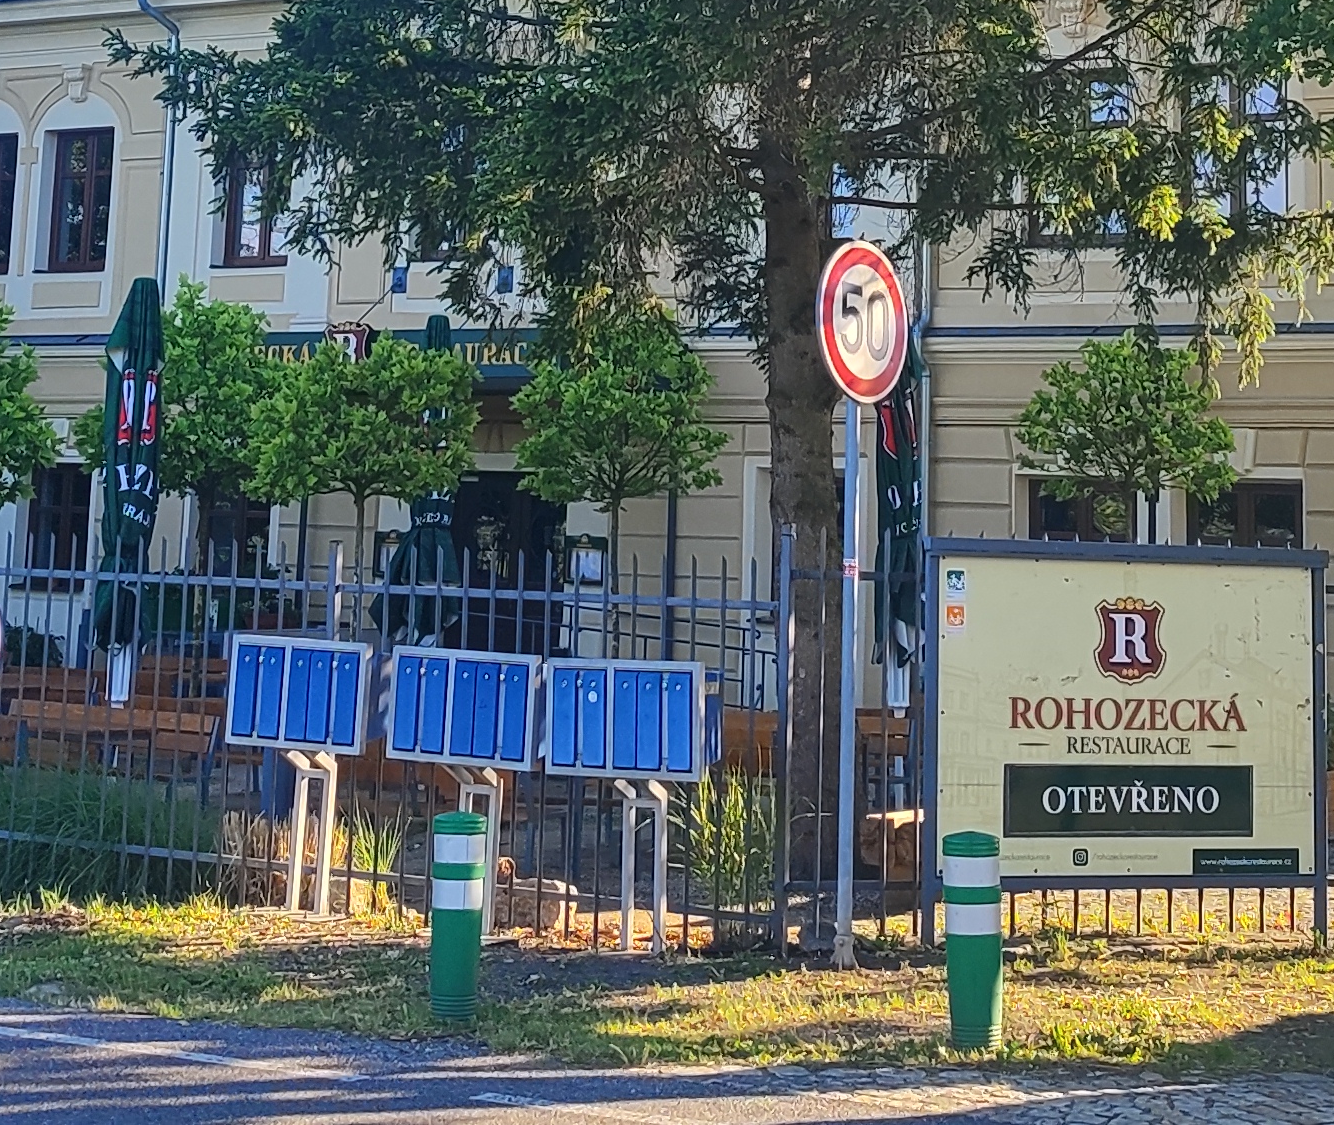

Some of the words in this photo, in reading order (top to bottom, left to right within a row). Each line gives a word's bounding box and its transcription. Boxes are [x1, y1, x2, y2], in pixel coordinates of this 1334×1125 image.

[841, 280, 889, 362] 50
[1108, 613, 1152, 664] R
[1008, 692, 1247, 732] ROHOZECKÁ
[1066, 736, 1191, 755] RESTAURACE
[1042, 780, 1220, 814] OTEVŘENO
